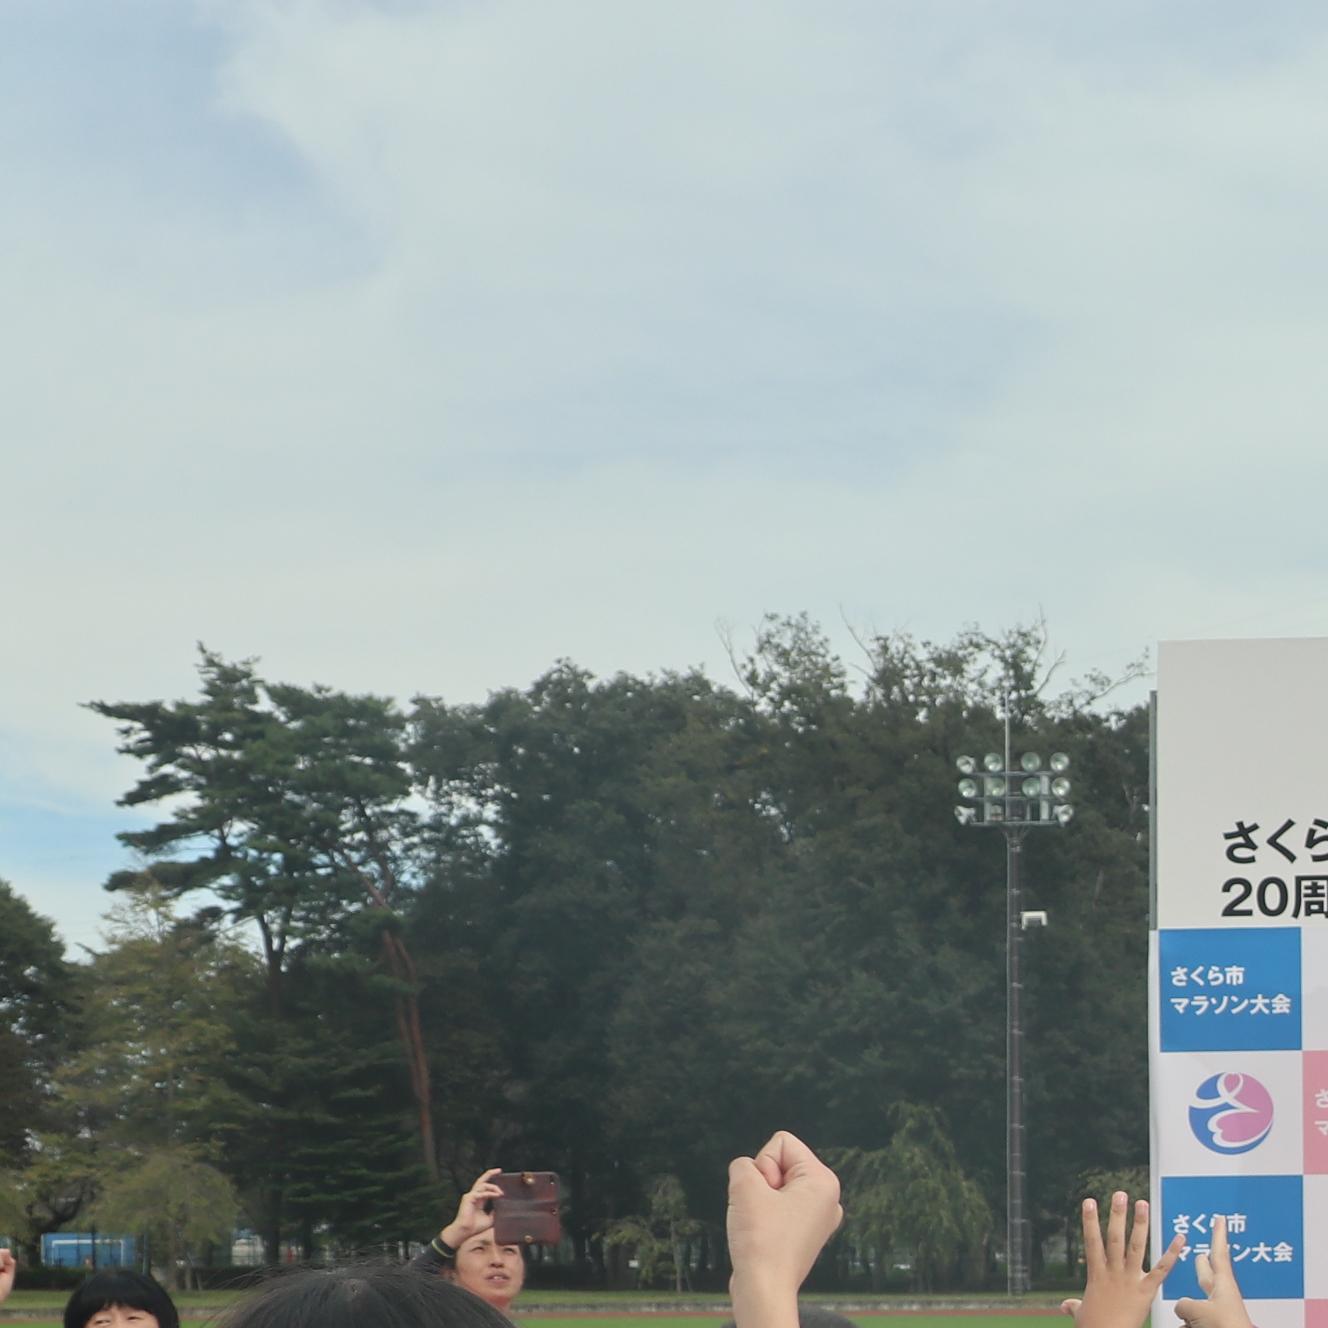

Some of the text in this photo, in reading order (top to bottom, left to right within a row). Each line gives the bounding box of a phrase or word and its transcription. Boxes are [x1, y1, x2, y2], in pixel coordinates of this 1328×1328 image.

[1171, 966, 1244, 986] さくら市
[1171, 994, 1291, 1015] マラソン大会
